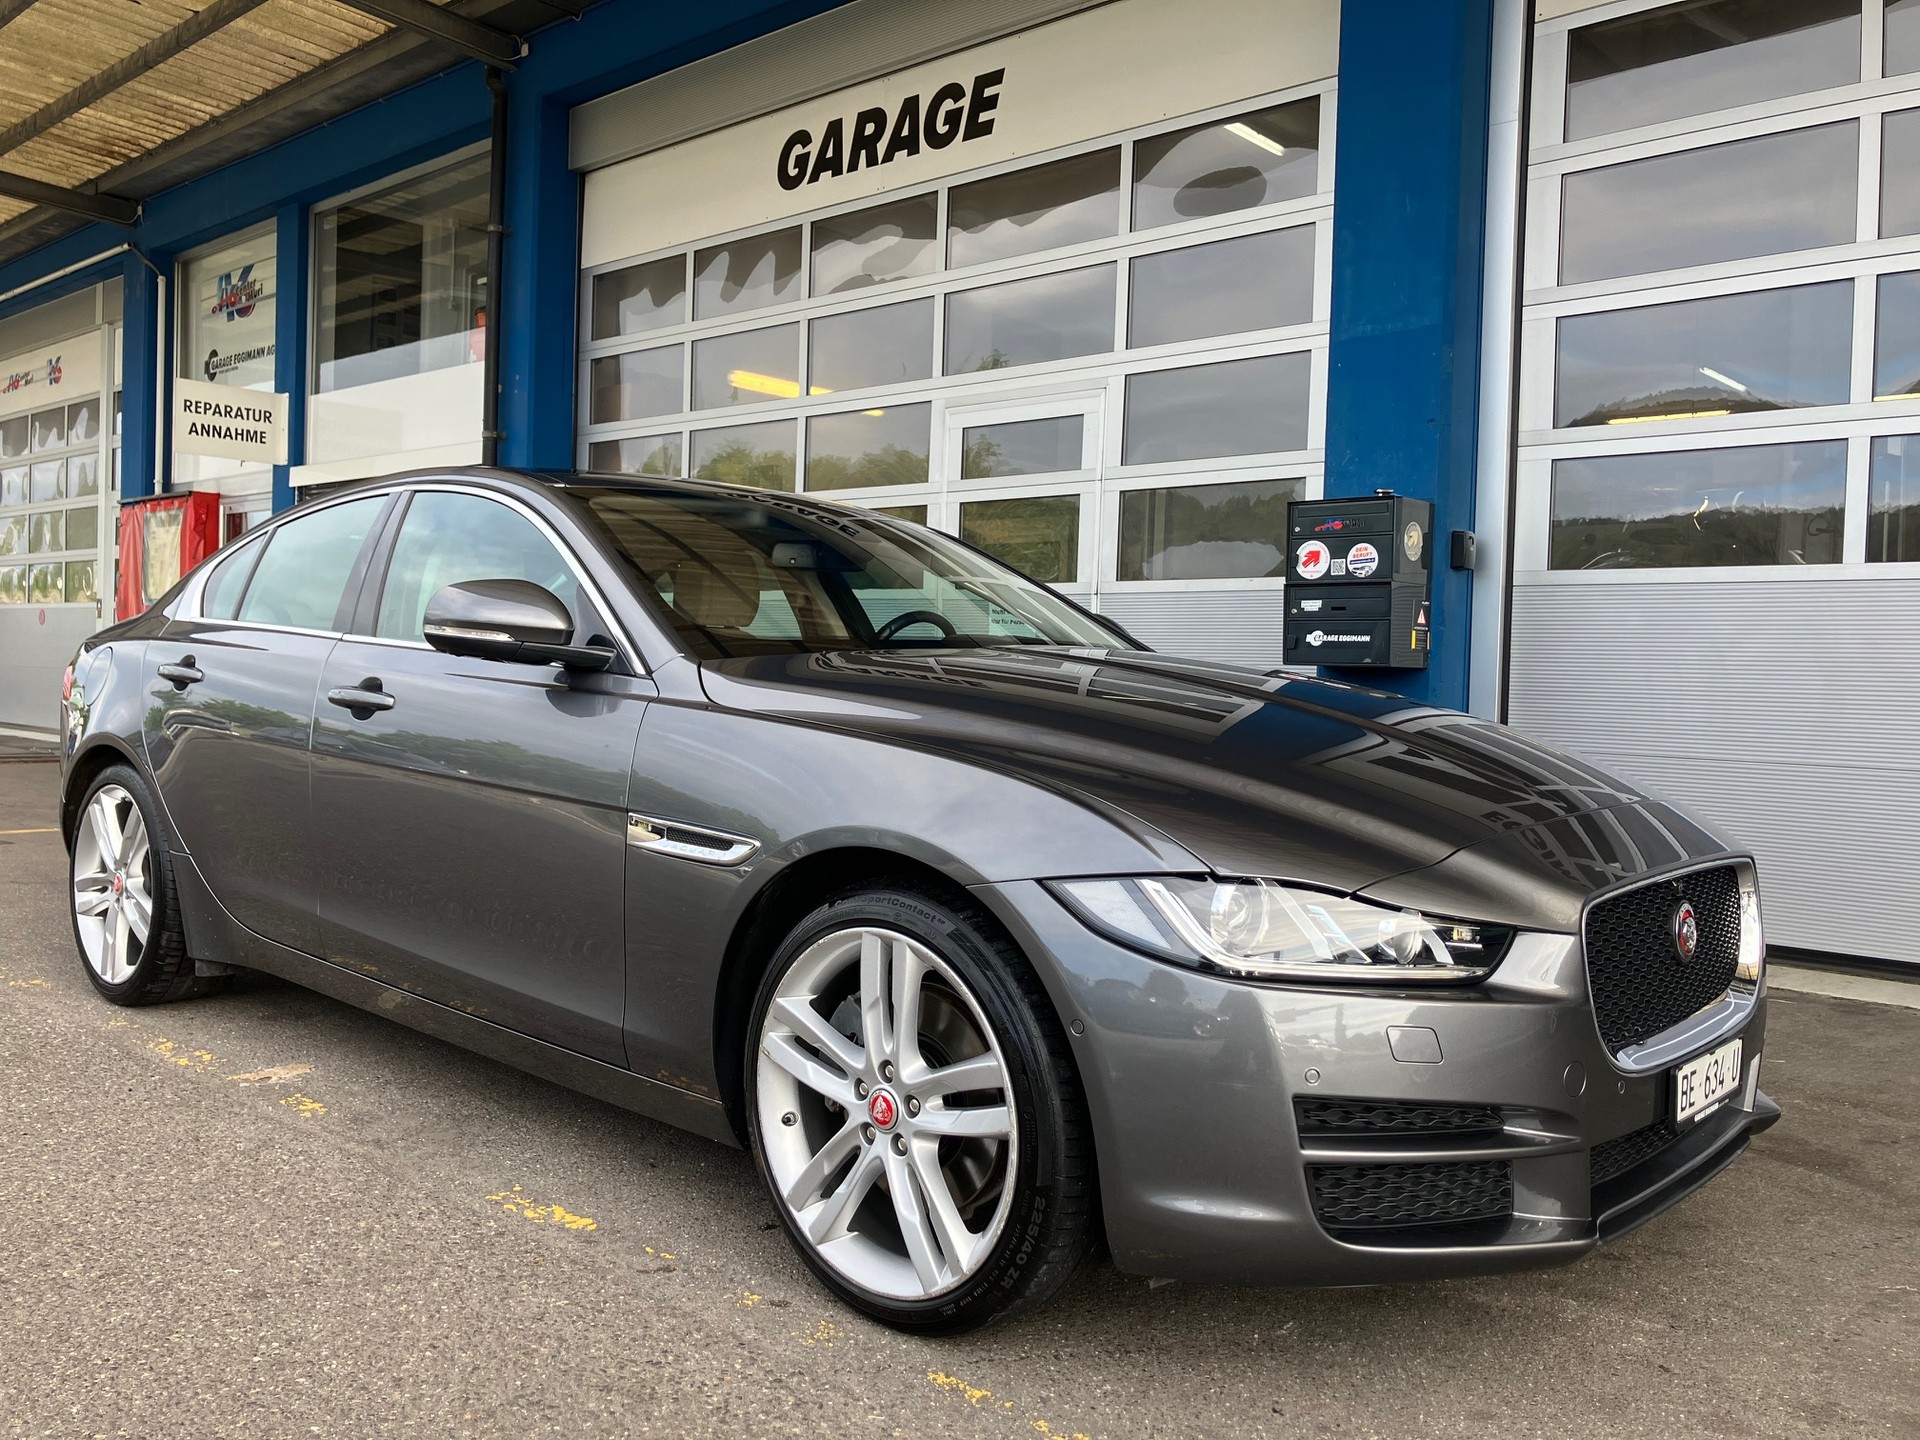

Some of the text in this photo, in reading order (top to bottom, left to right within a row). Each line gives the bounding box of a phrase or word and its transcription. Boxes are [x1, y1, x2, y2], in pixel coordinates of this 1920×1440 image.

[777, 67, 1006, 191] GARAGE
[210, 355, 233, 371] GARAGE
[233, 346, 266, 365] EGGIMANN
[266, 345, 275, 356] AG
[183, 399, 273, 424] REPARATUR
[188, 422, 267, 445] ANNAHME
[1314, 634, 1371, 643] GARAGE EGGIMANN
[1680, 1069, 1697, 1112] BE
[1704, 1054, 1726, 1099] 634
[1731, 1046, 1740, 1082] U
[1015, 1195, 1046, 1265] 225/40
[1000, 1265, 1020, 1289] ZR
